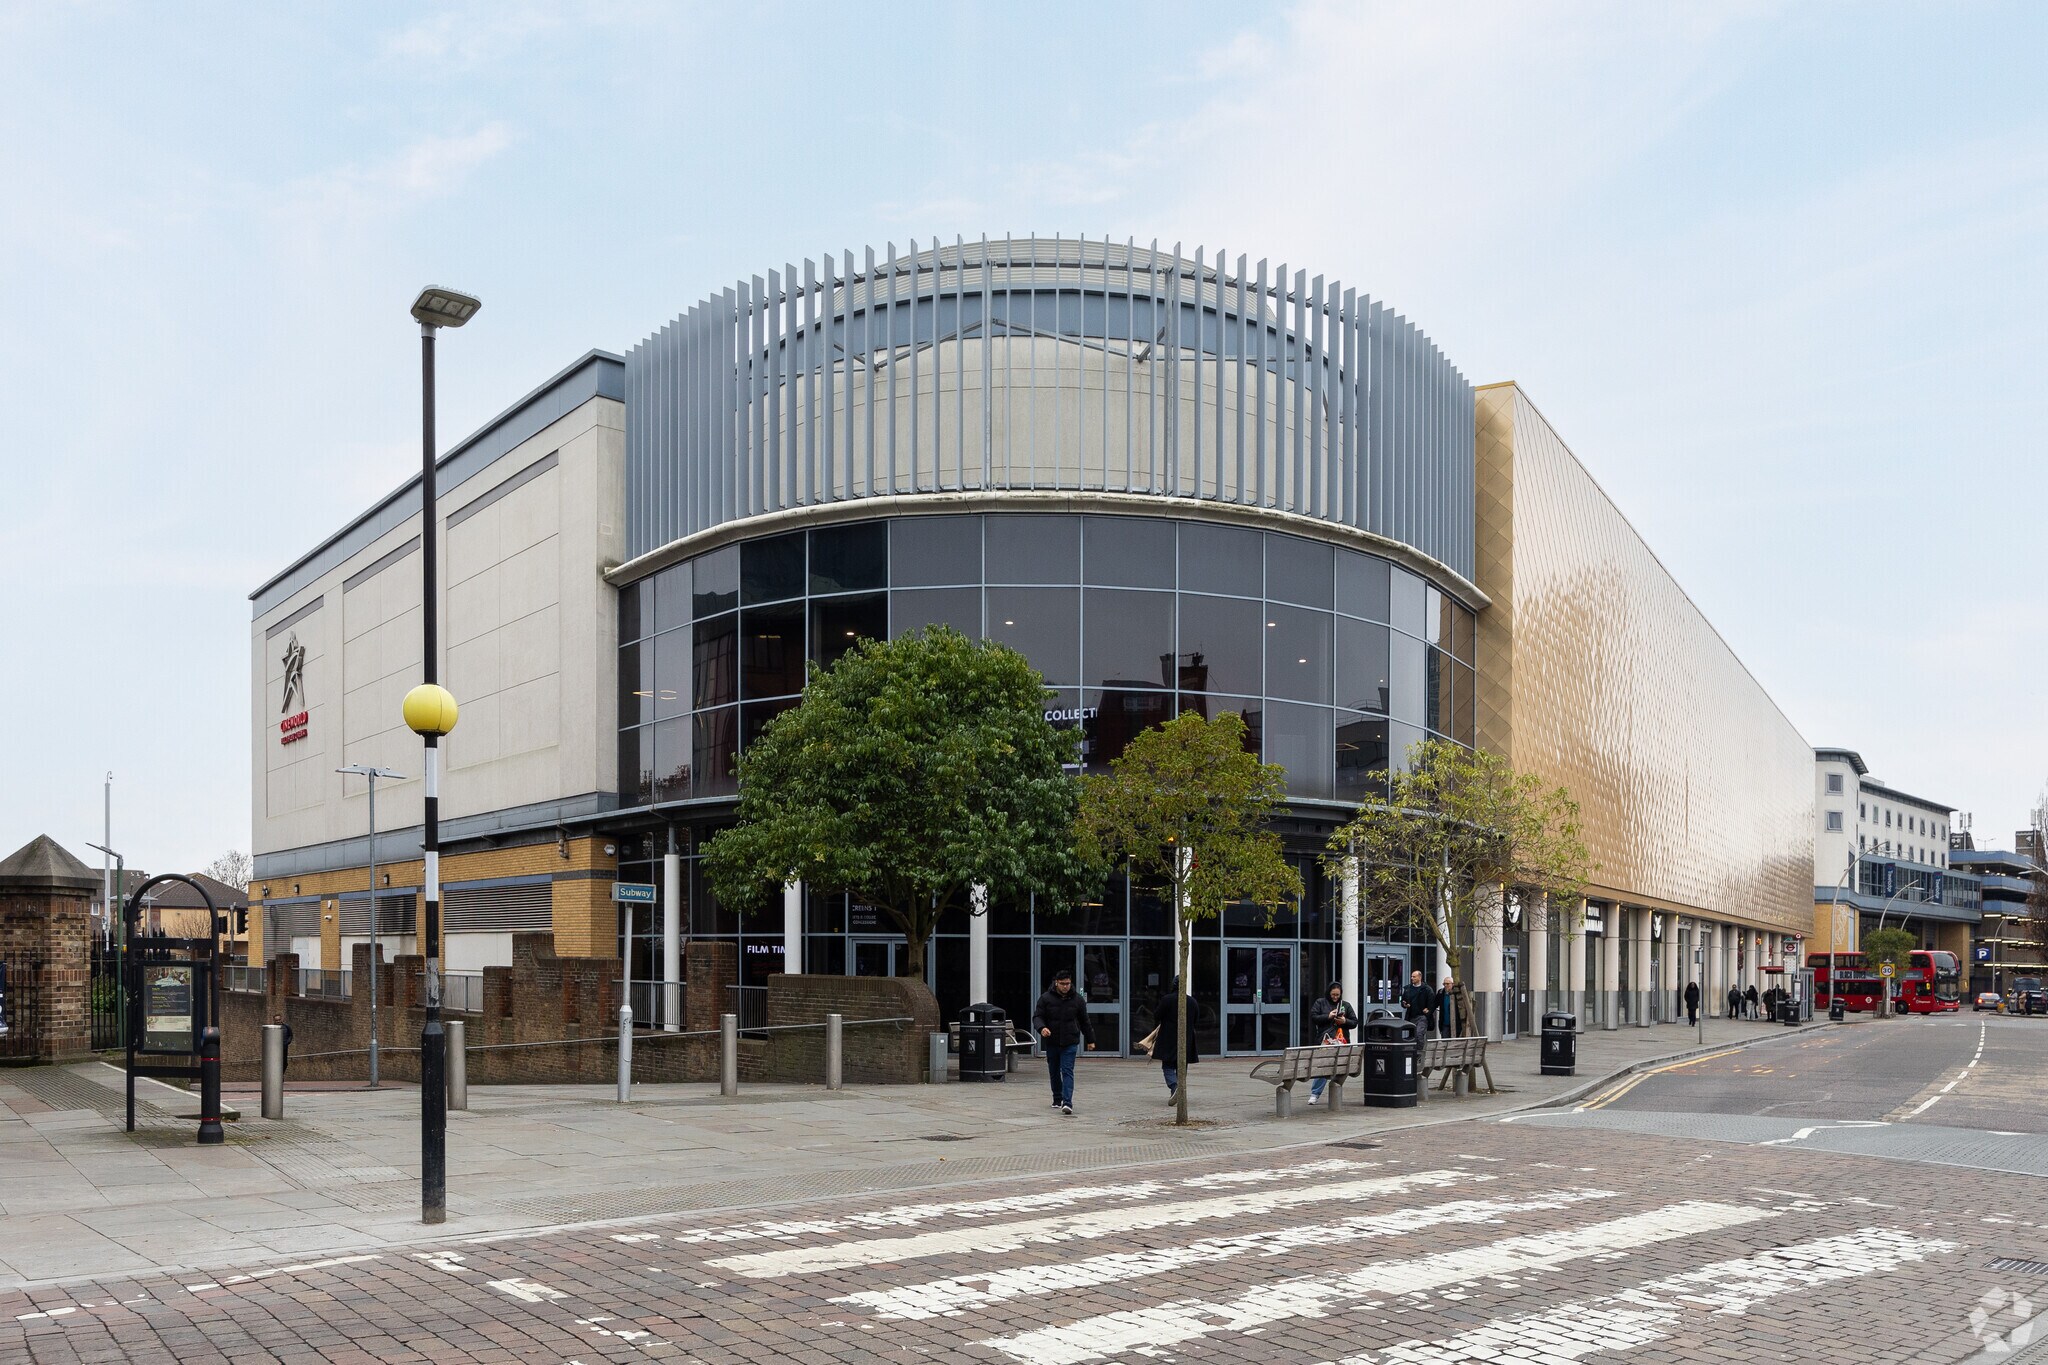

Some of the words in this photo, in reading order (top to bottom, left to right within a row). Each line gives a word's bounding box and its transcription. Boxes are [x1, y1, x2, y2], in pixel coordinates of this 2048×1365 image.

[620, 887, 652, 898] Subway
[747, 945, 769, 954] FILM
[1979, 950, 1987, 958] P
